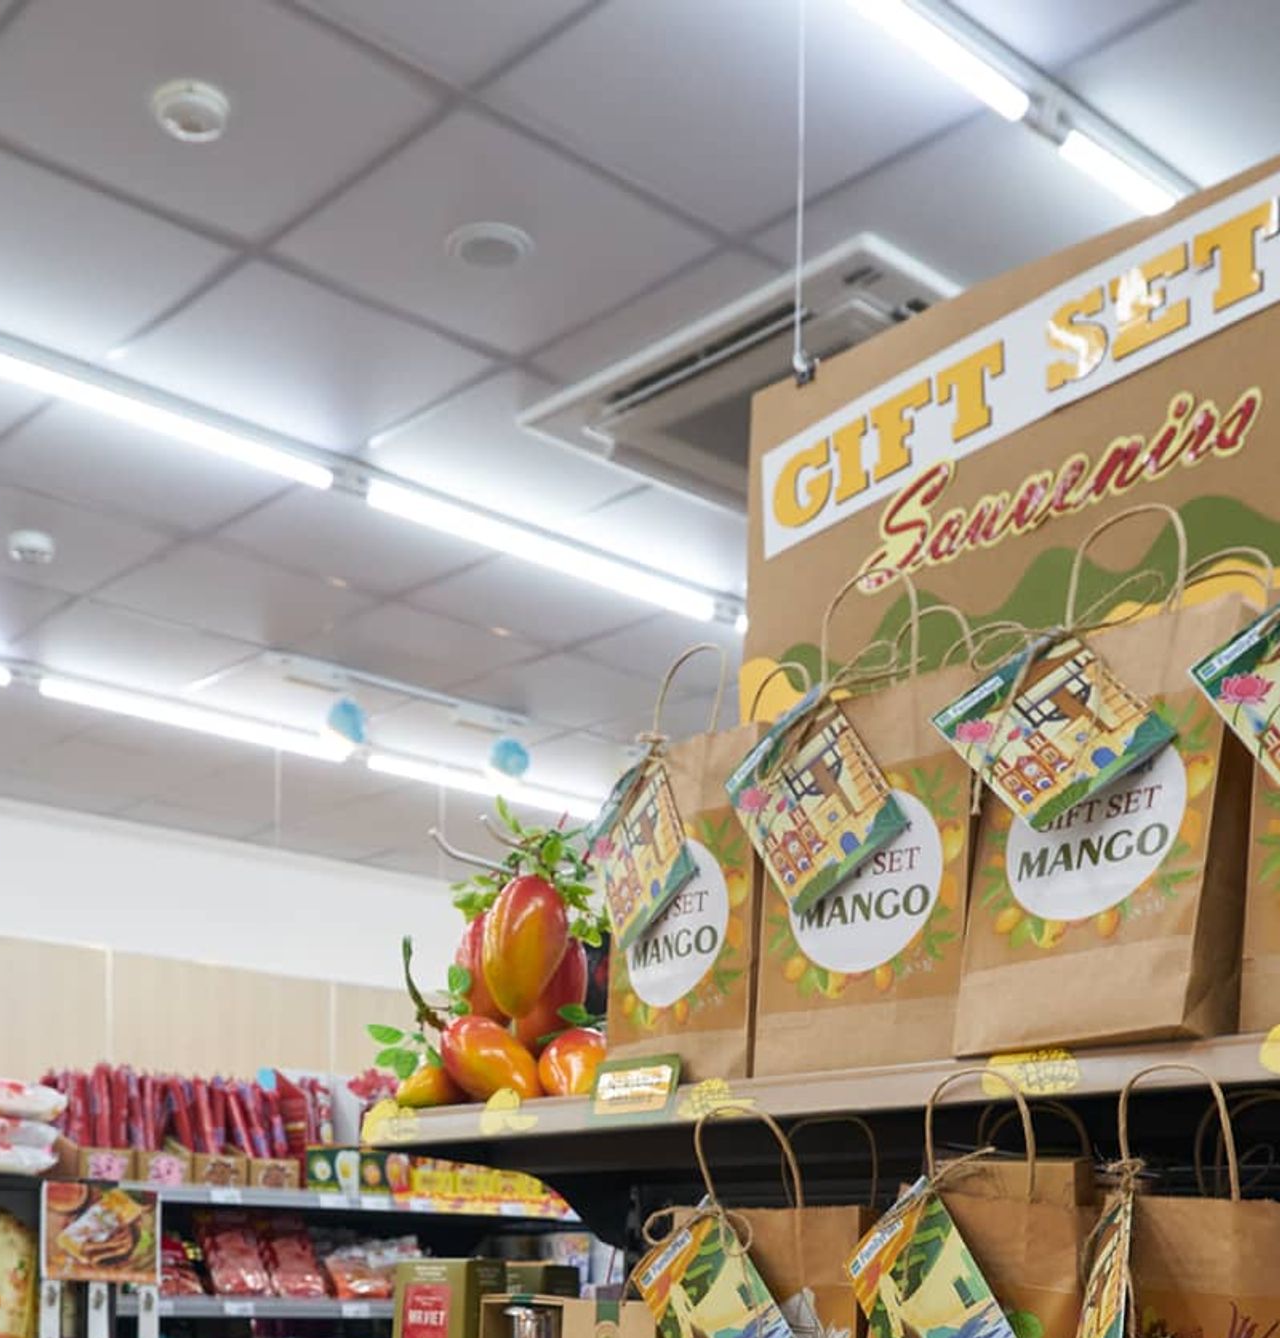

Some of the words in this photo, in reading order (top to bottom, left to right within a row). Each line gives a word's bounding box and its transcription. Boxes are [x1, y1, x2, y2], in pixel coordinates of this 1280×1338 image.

[771, 339, 1006, 527] GIFT
[856, 387, 1263, 591] Souvenirs
[1103, 784, 1163, 822] SET
[873, 845, 923, 877] SET
[1016, 822, 1170, 882] MANGO
[799, 884, 931, 933] MANGO
[631, 924, 718, 972] MANGO
